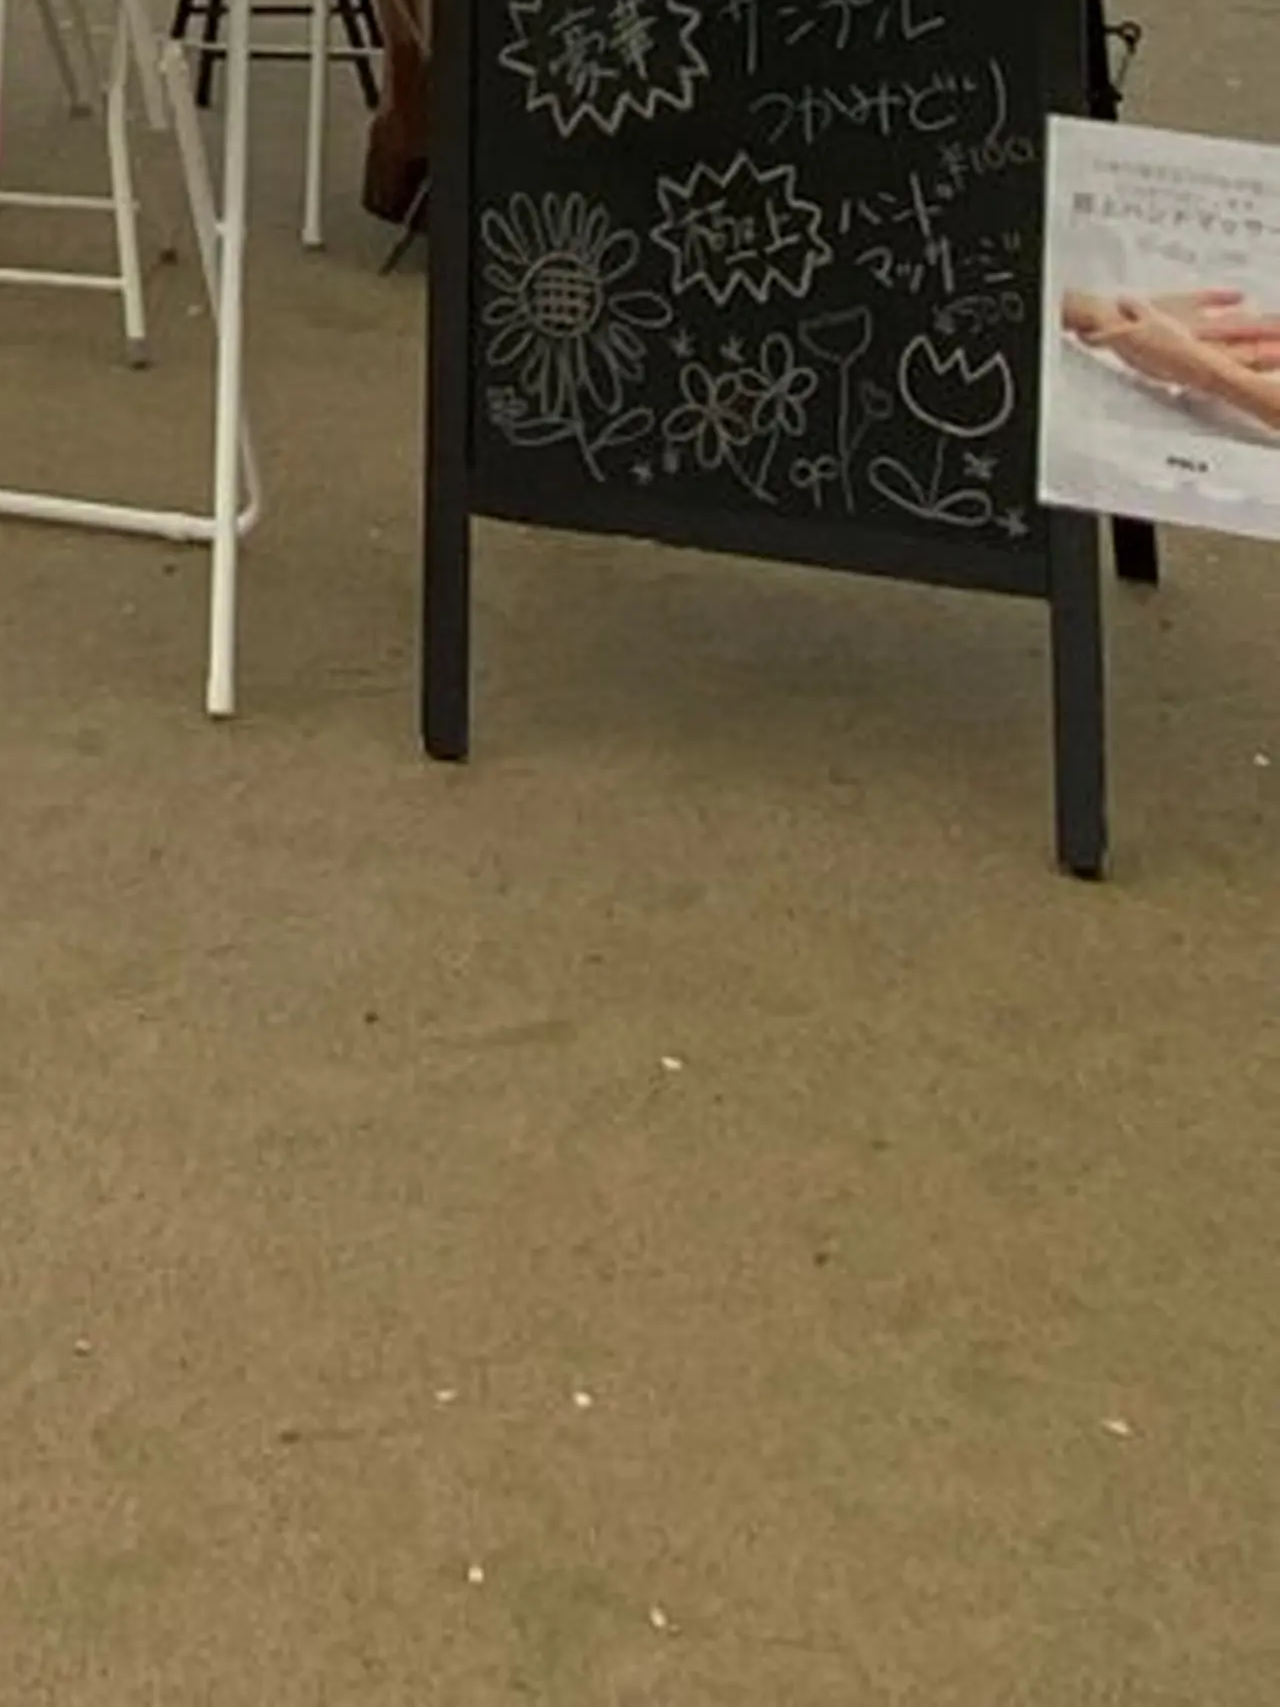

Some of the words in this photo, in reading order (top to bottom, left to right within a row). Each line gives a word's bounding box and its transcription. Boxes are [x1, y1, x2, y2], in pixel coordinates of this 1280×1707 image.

[676, 197, 802, 267] 極上
[837, 170, 956, 237] ハンド
